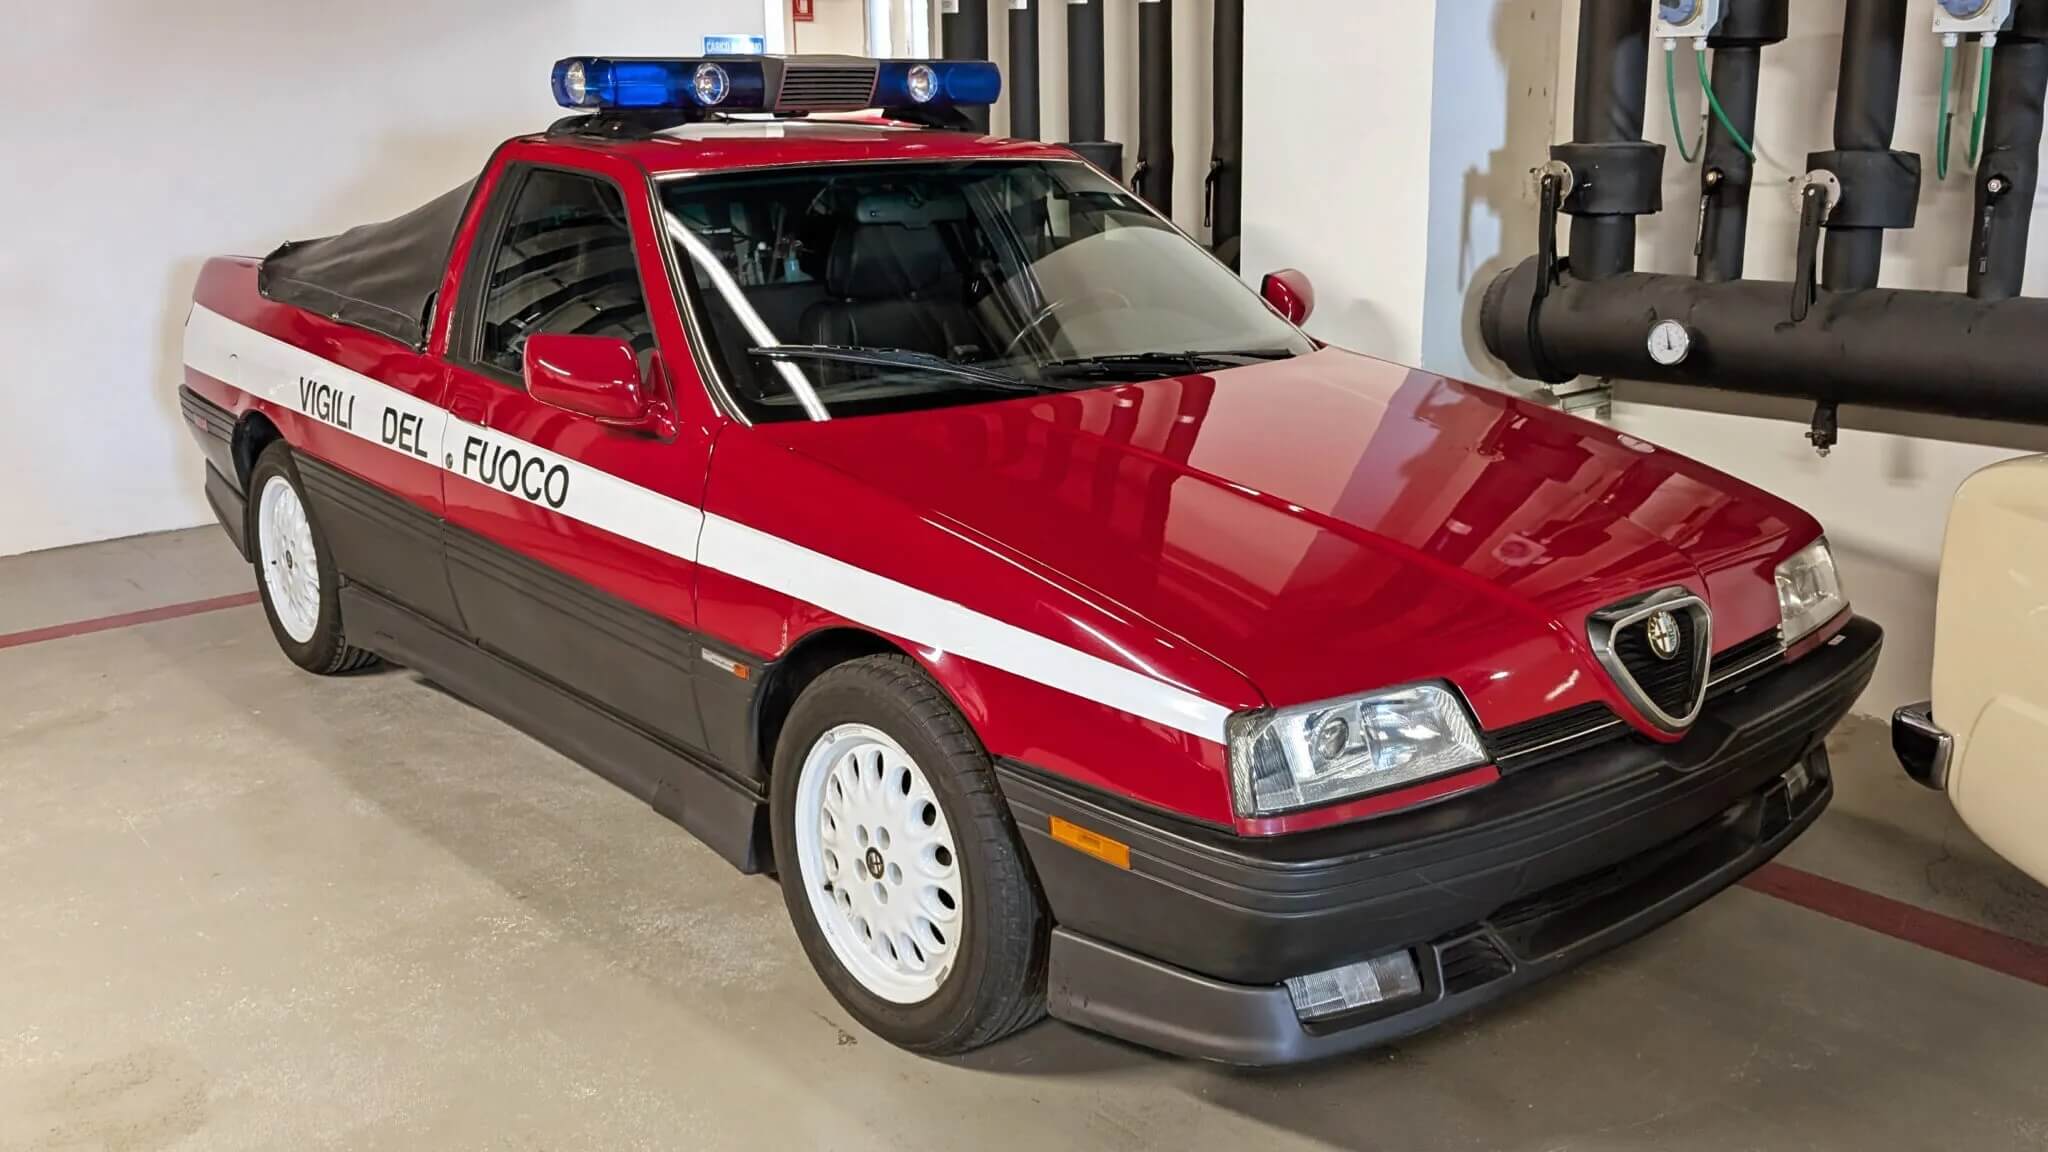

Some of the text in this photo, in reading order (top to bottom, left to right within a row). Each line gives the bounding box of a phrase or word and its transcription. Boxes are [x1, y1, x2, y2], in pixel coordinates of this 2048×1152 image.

[299, 376, 570, 509] VIGILI DEL FUOCO
